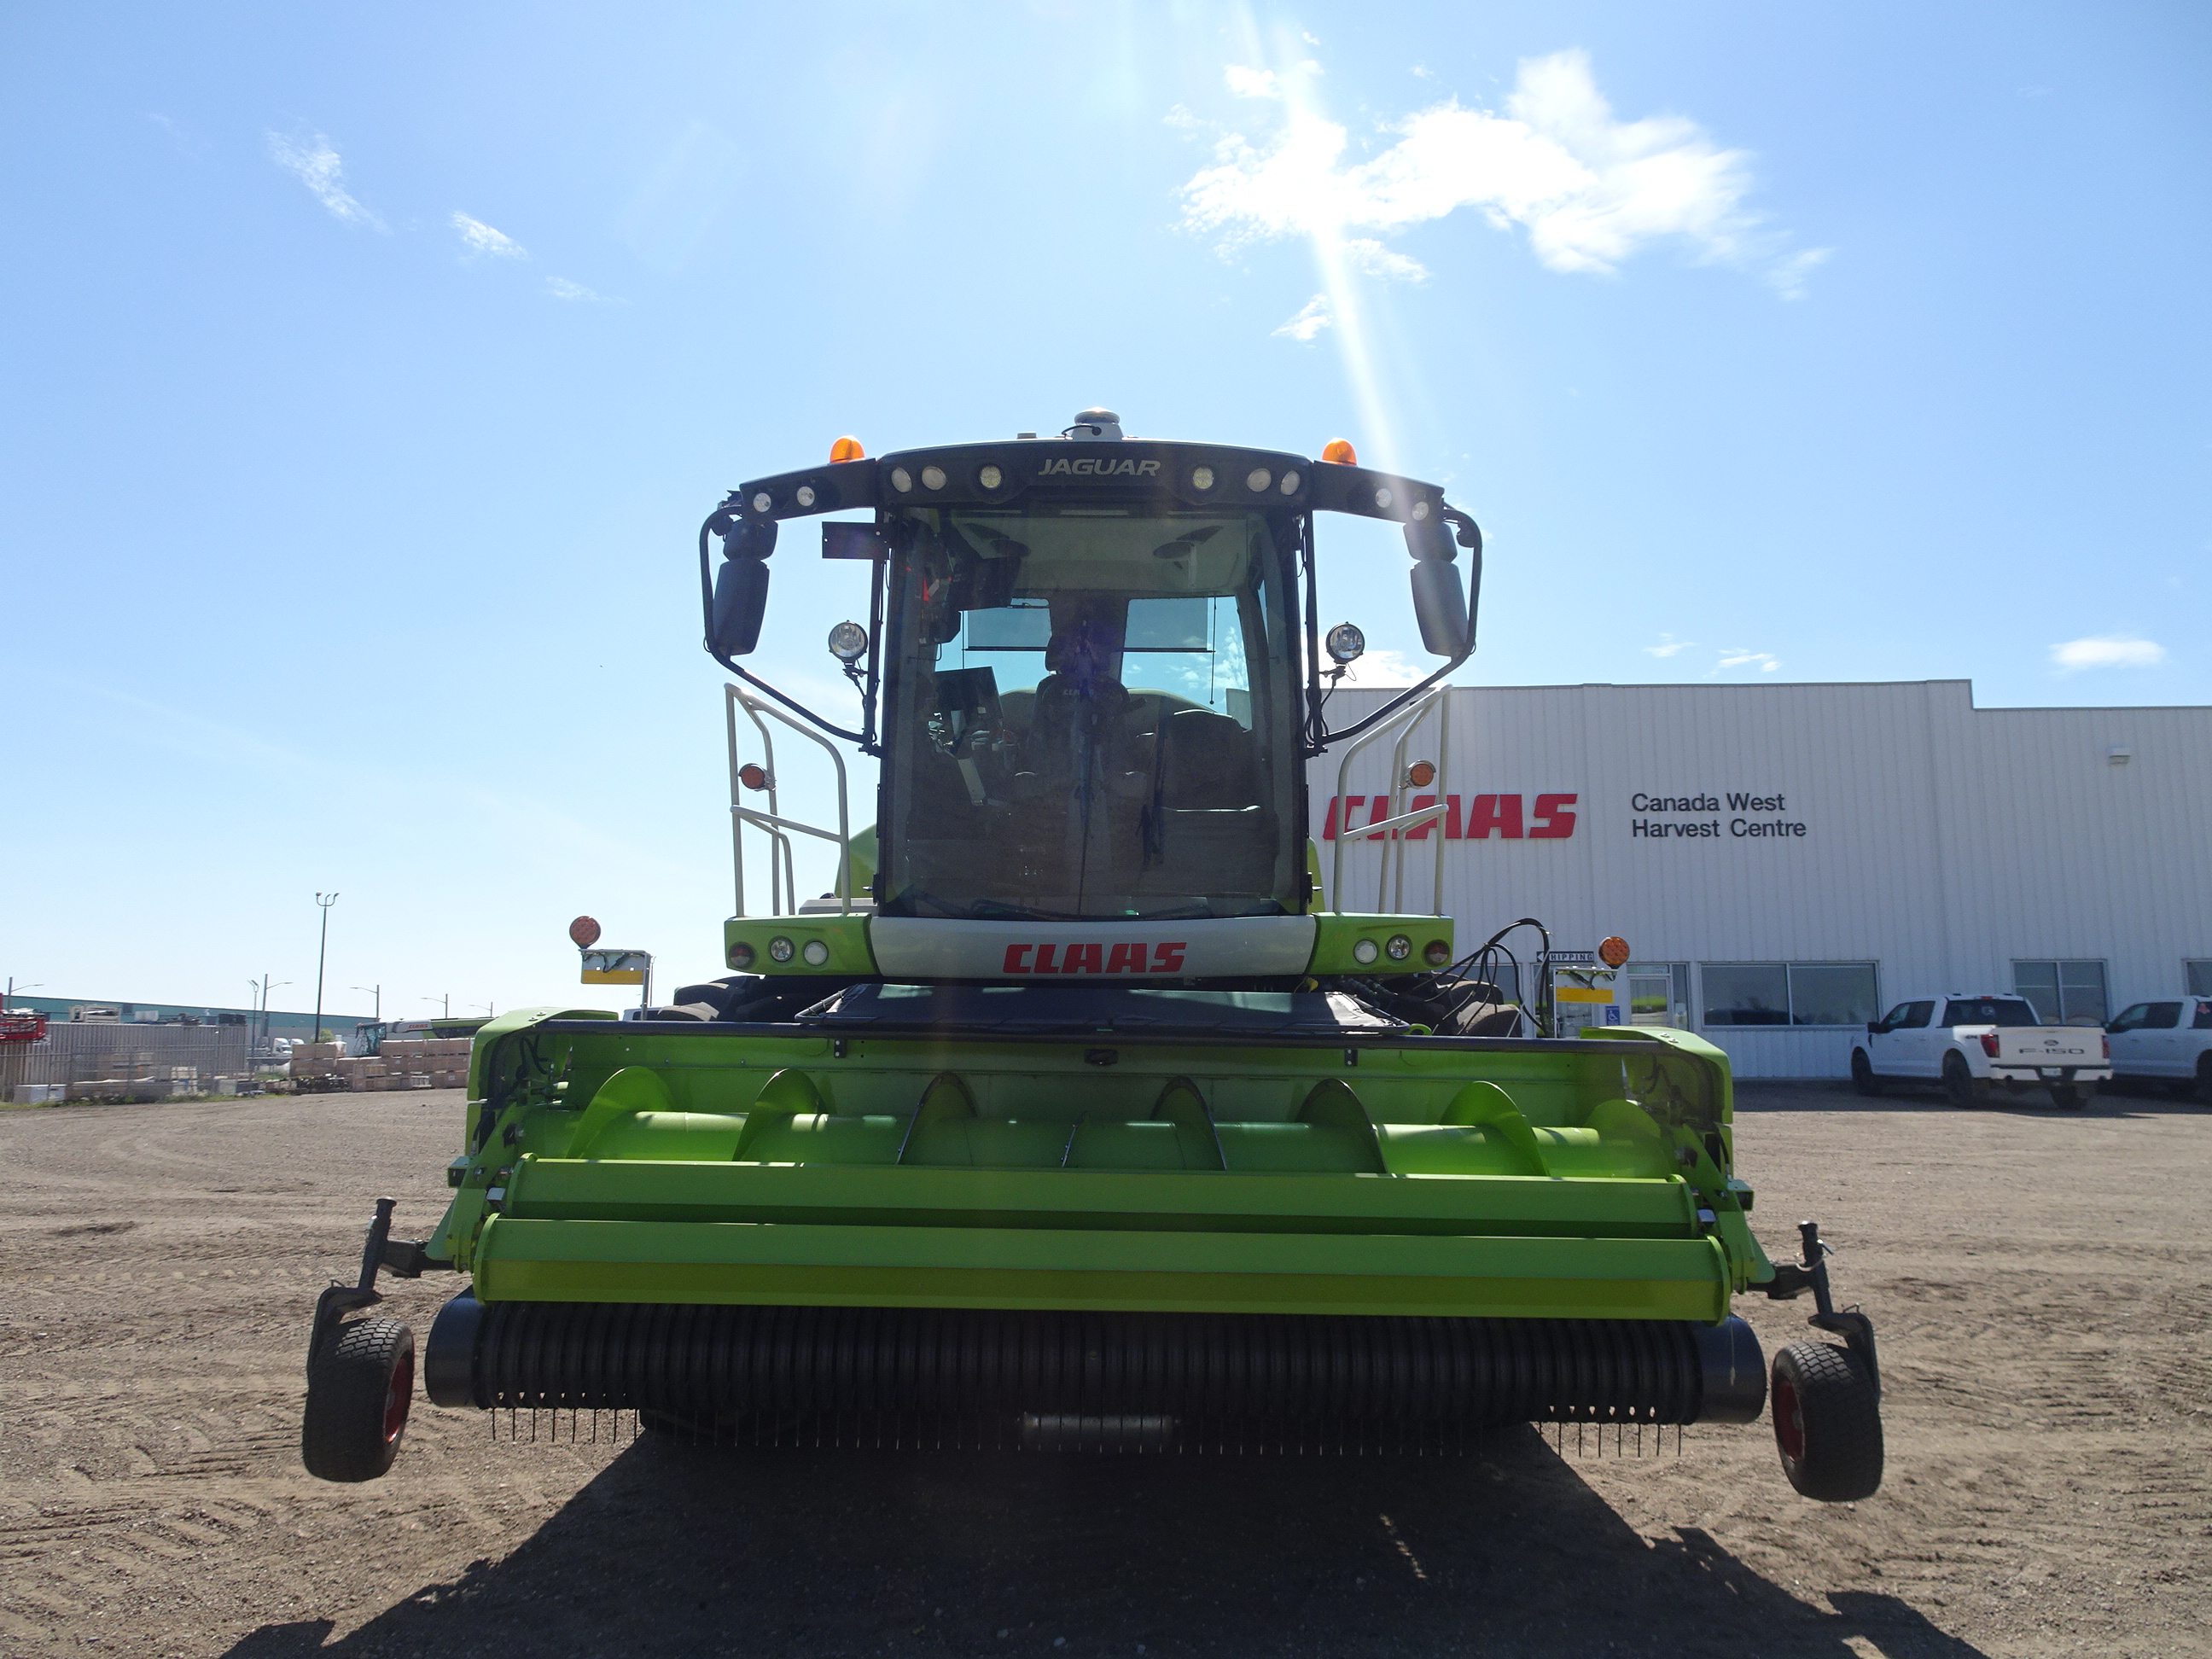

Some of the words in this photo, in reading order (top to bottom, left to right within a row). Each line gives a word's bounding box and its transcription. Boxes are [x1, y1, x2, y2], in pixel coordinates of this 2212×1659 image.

[1038, 458, 1161, 476] JAGUAR
[1632, 793, 1720, 812] Canada
[1726, 793, 1785, 811] West
[1633, 819, 1720, 837] Harvest
[1731, 818, 1807, 837] Centre
[1003, 942, 1187, 974] CLAAS
